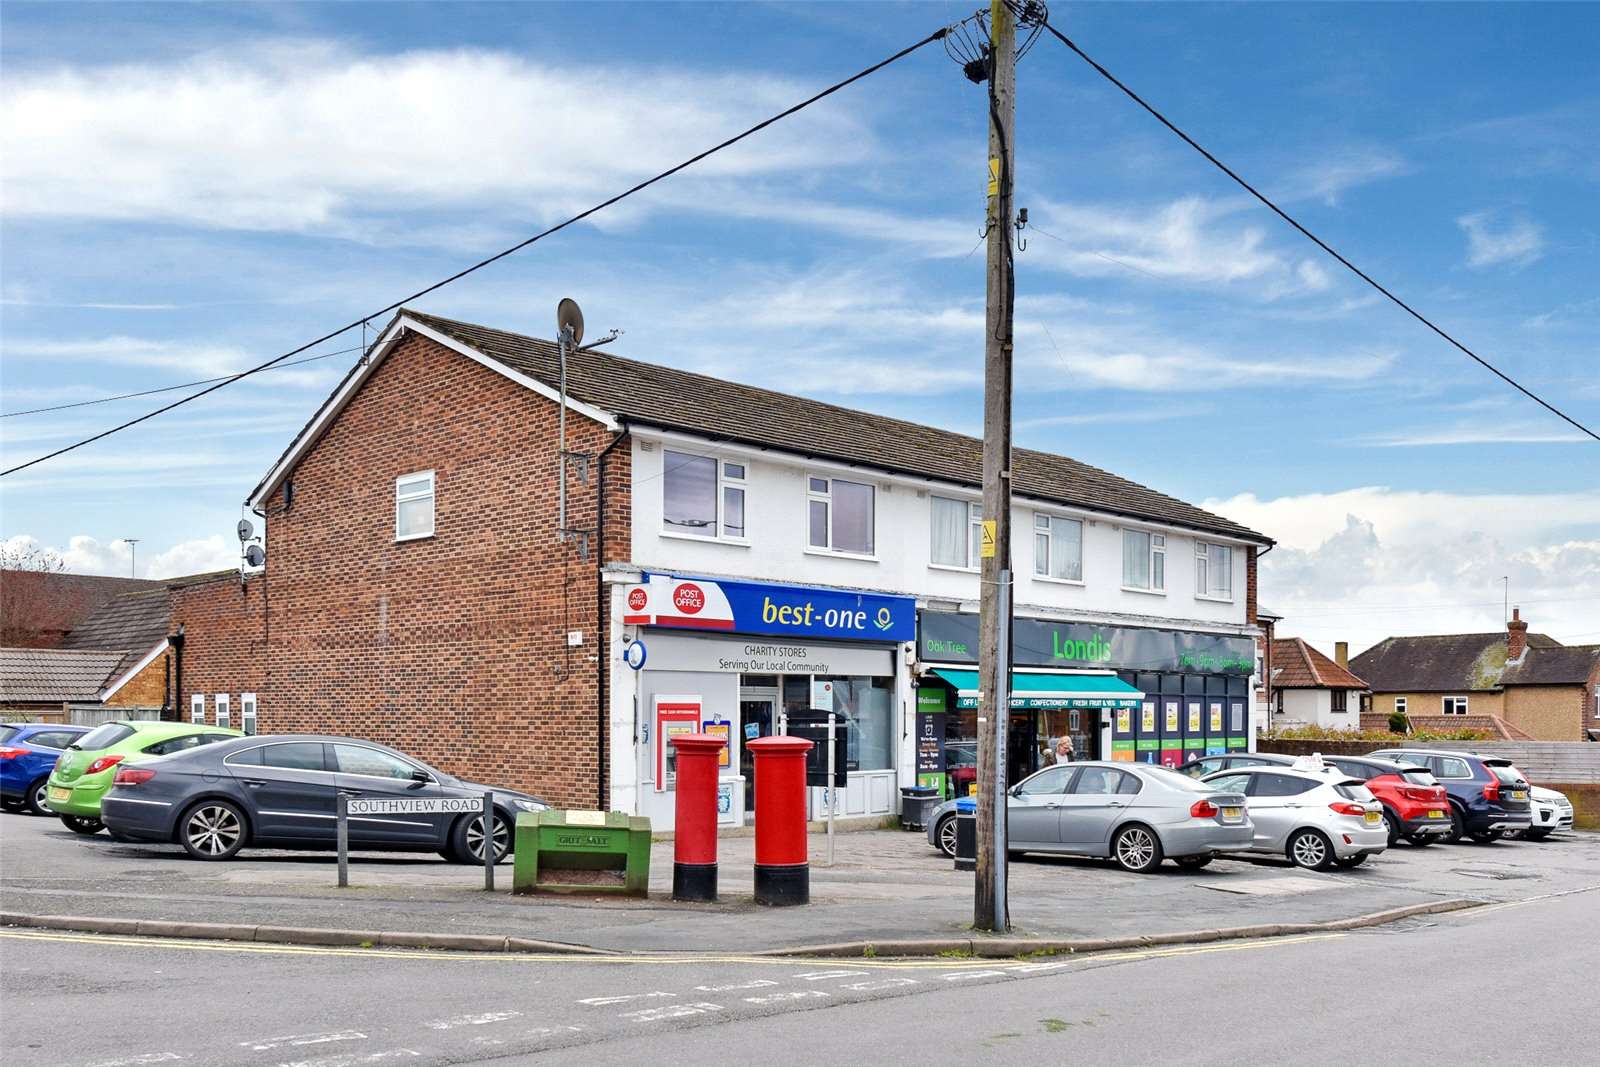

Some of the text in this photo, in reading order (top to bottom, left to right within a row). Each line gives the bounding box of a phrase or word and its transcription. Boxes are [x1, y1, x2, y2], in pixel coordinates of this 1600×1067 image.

[631, 592, 644, 600] POST
[679, 589, 700, 599] POST
[629, 598, 646, 607] OFFICE
[675, 598, 702, 609] OFFICE
[762, 596, 867, 630] best-one
[744, 645, 807, 658] CHARITY STORES
[927, 639, 967, 655] Oak Tree
[1053, 631, 1112, 662] Londis
[719, 658, 830, 673] Serving Our Local Community
[1030, 699, 1069, 707] CONFECTIONERY
[351, 799, 480, 813] SOUTHVIEW ROAD
[559, 836, 609, 845] GRIT SALT
